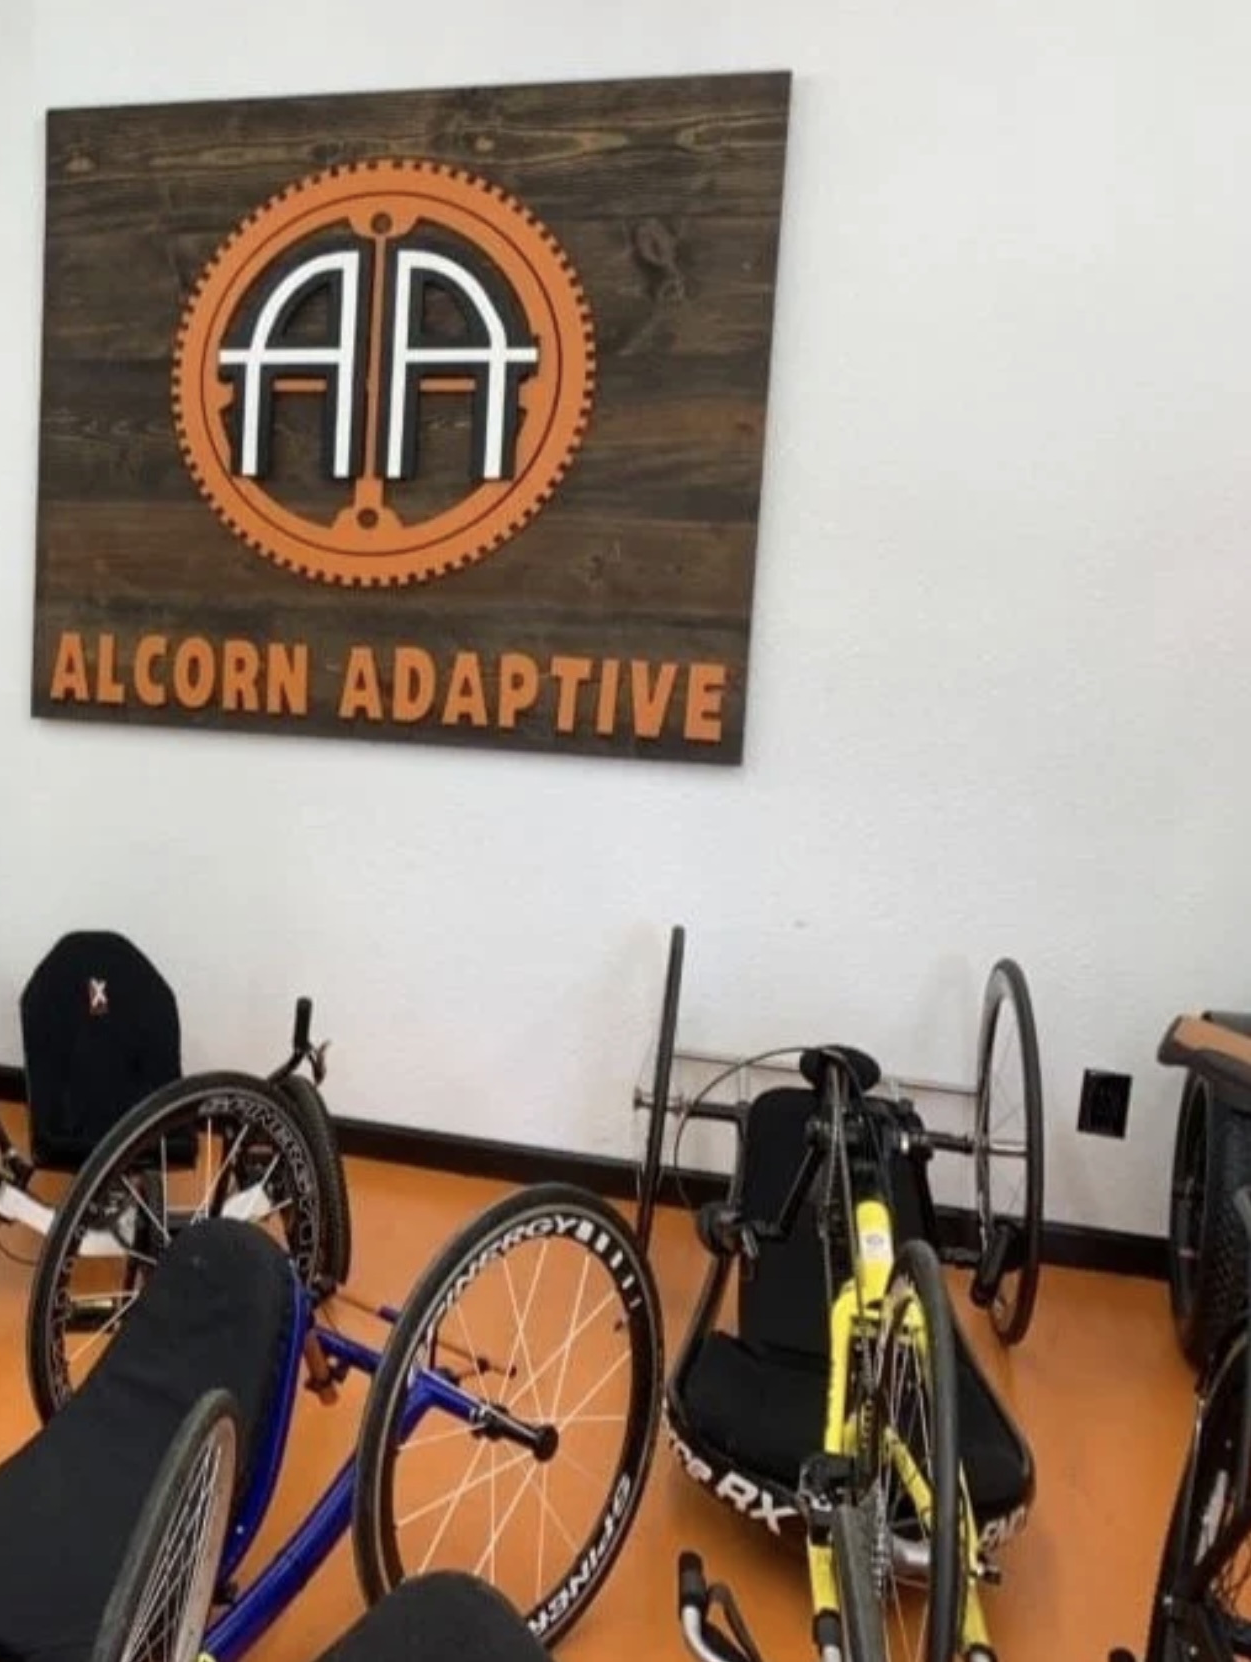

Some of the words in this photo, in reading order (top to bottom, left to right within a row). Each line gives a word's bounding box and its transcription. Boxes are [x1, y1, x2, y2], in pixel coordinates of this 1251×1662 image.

[219, 250, 538, 479] AA
[51, 632, 309, 712] ALCORN
[339, 644, 723, 742] ADAPTIVE
[715, 1470, 799, 1537] RX
